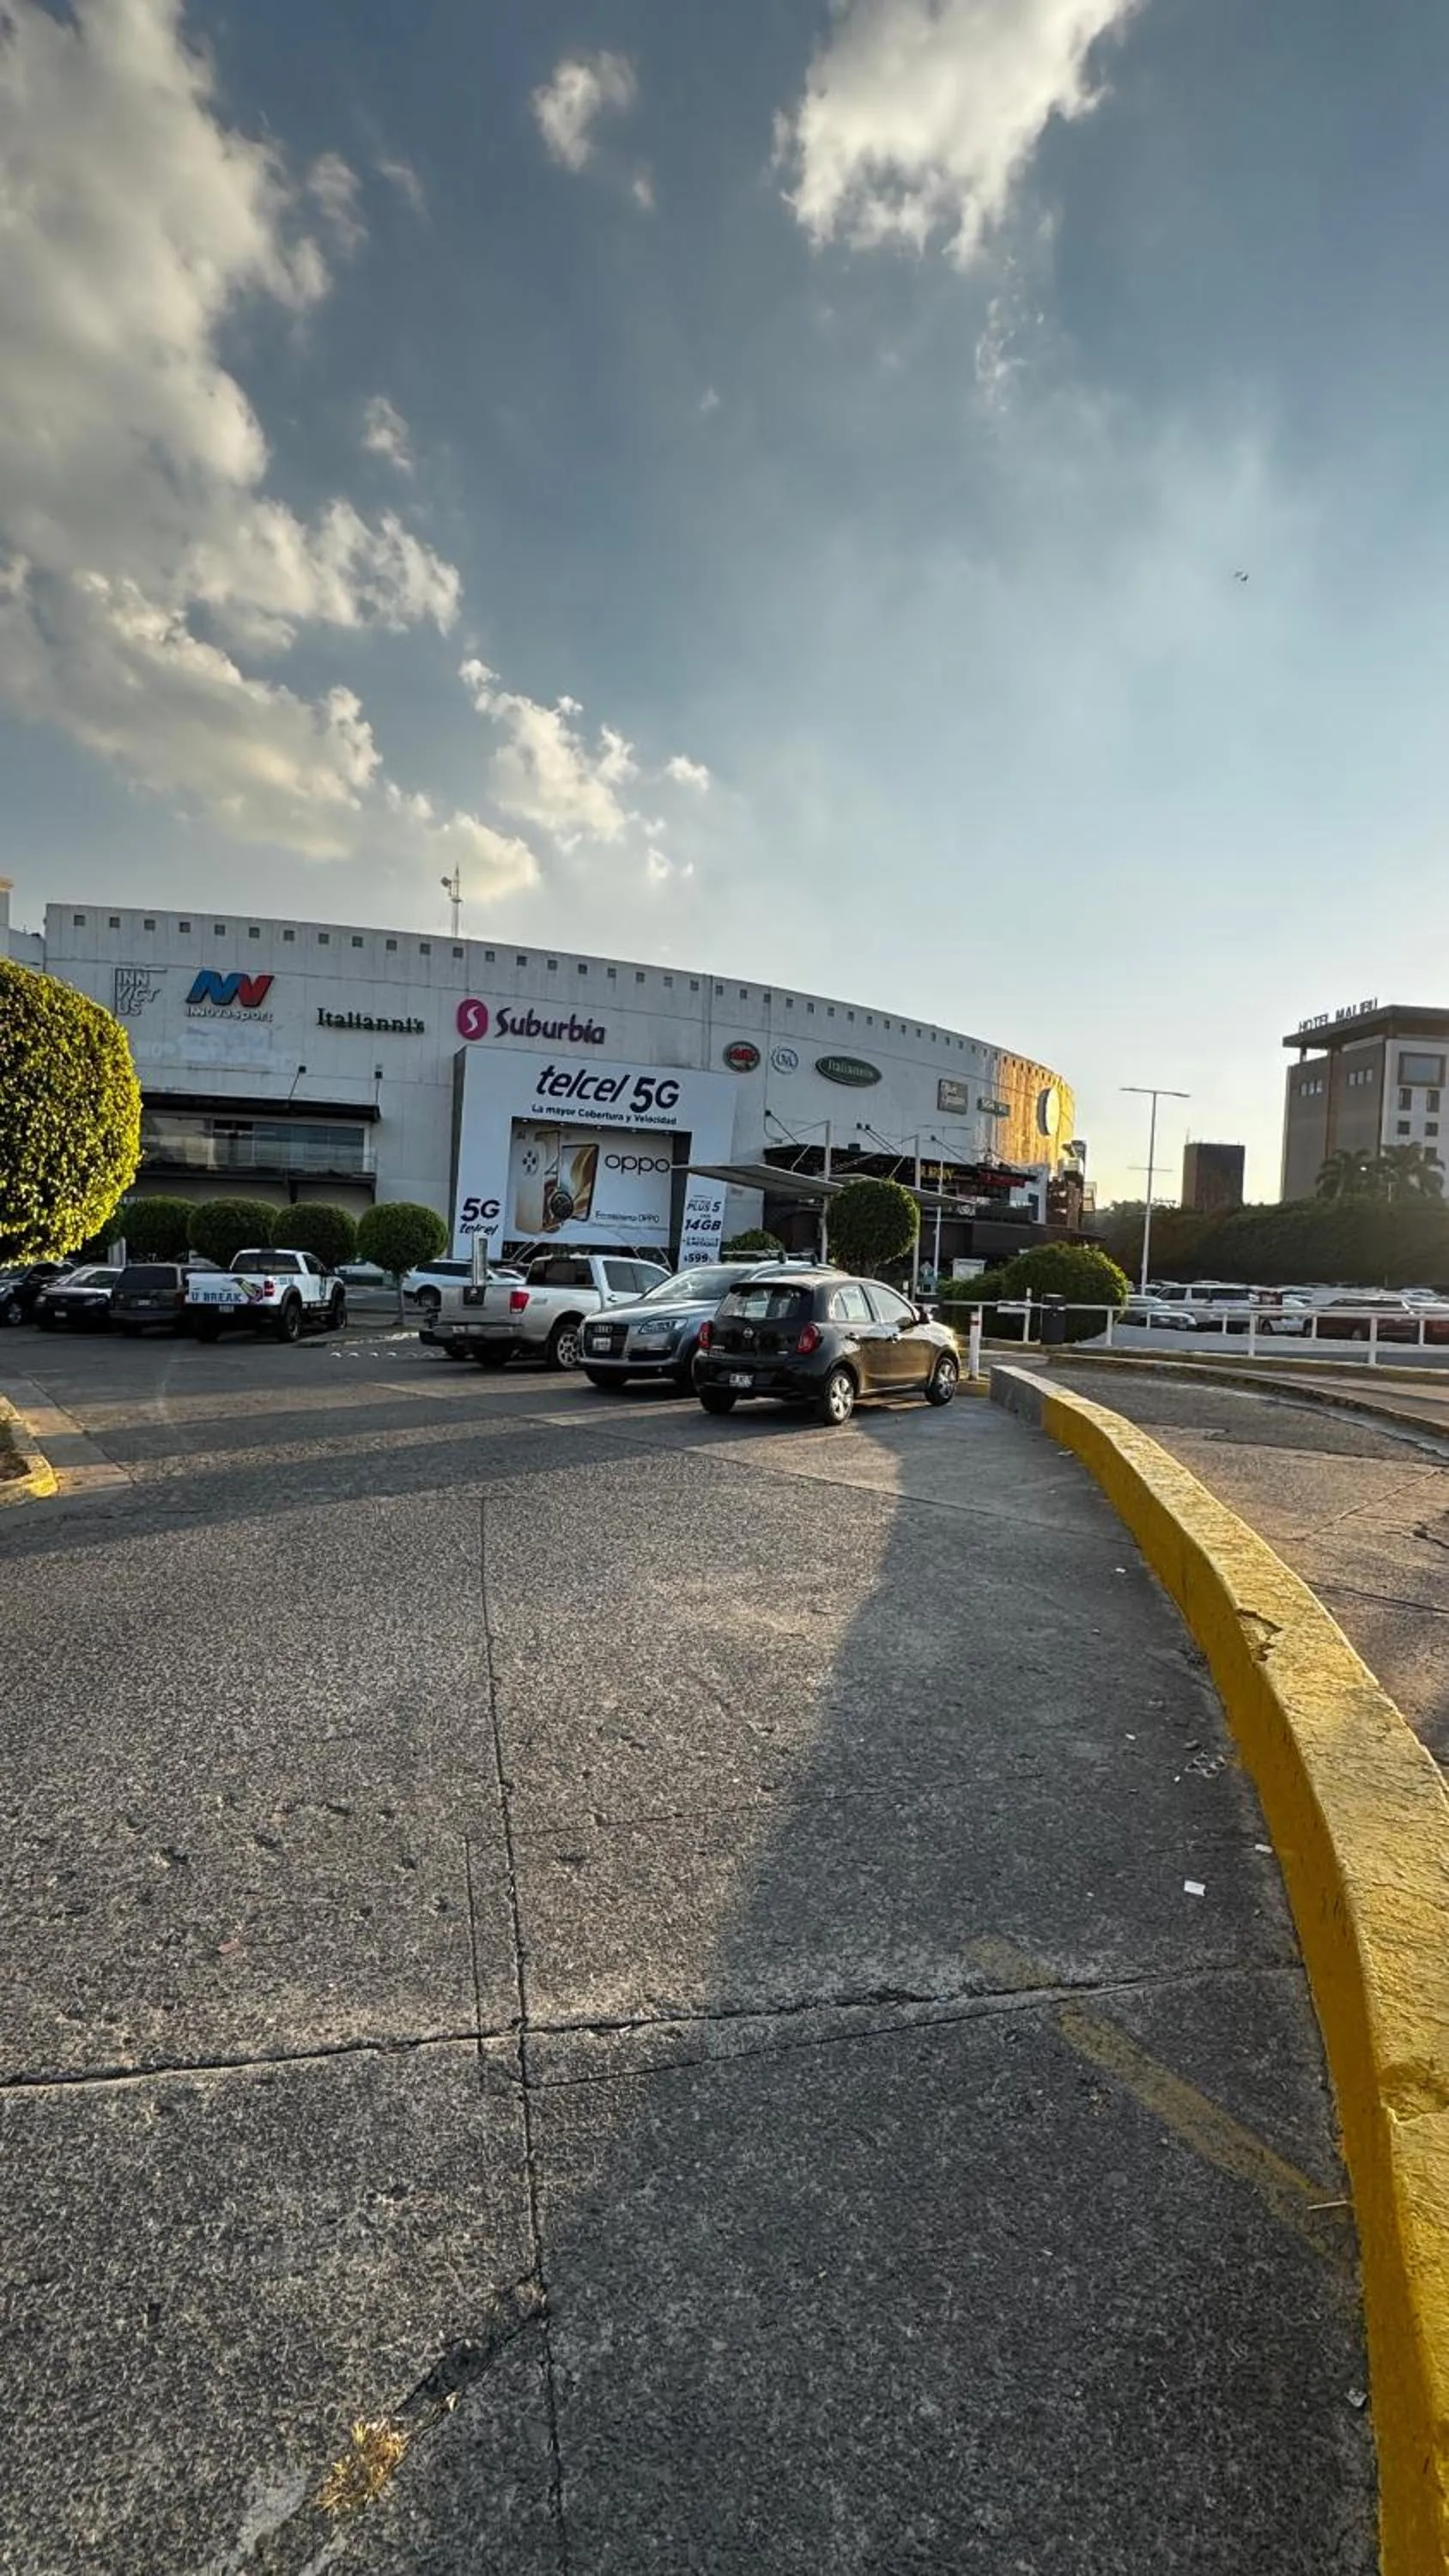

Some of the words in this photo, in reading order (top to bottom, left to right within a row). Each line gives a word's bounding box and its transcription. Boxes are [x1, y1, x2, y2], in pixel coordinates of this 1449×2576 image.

[317, 1007, 425, 1034] Italianni's
[494, 1007, 606, 1045] Suburbia
[1298, 1013, 1329, 1032] HOTEL
[536, 1065, 631, 1103] telcel
[629, 1077, 681, 1114] 5G
[532, 1104, 543, 1115] La
[546, 1105, 575, 1117] mayor
[578, 1108, 624, 1122] Cobertura
[634, 1113, 677, 1125] Velocidad
[604, 1154, 670, 1176] oppo
[460, 1198, 501, 1222] 5G
[684, 1218, 722, 1230] 14GB
